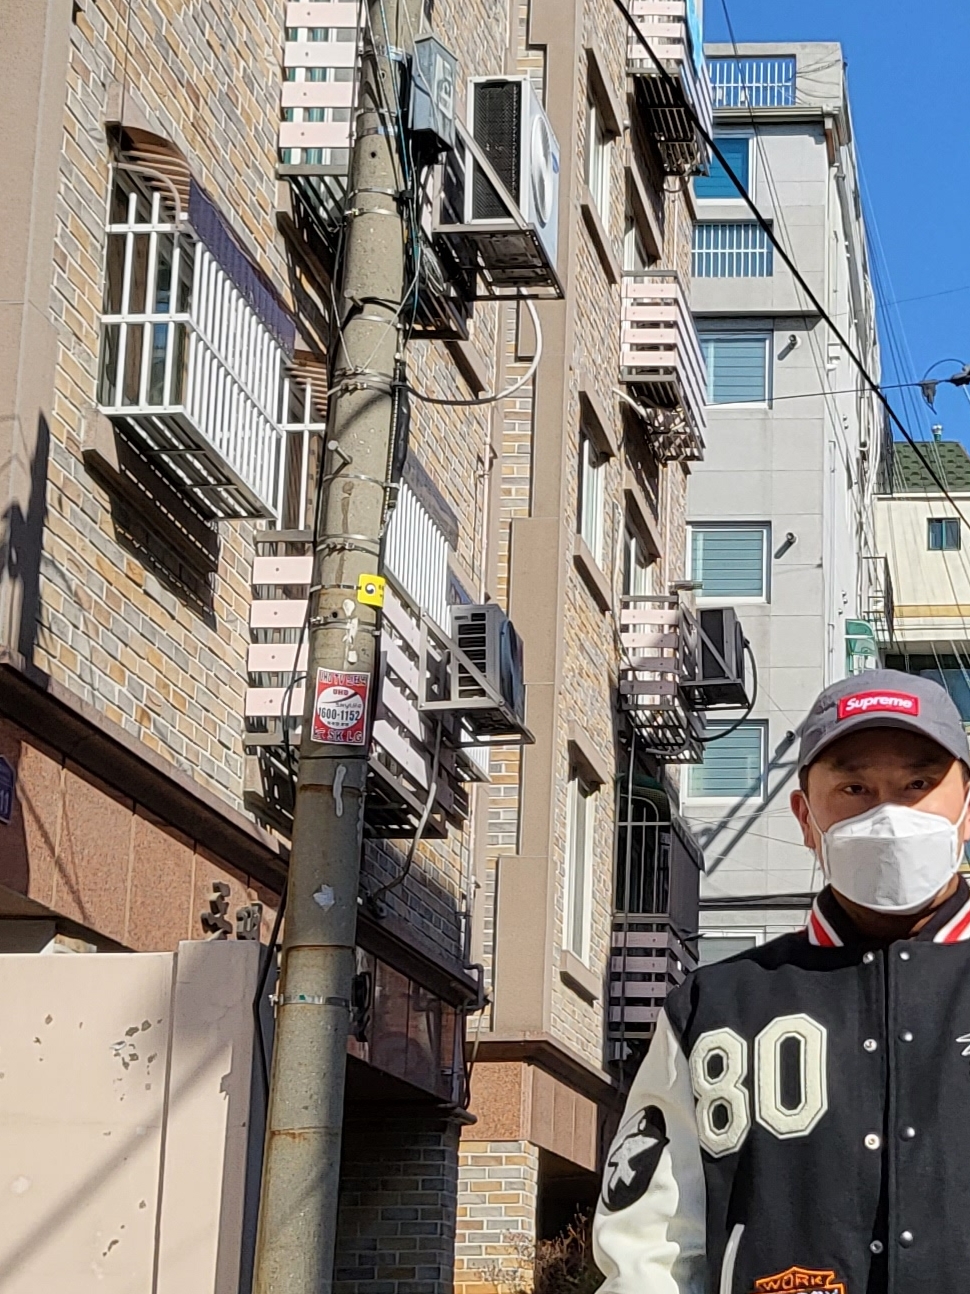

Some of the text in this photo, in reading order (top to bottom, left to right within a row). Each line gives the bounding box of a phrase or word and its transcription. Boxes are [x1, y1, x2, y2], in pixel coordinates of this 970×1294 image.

[845, 696, 913, 711] Supreme
[689, 1013, 828, 1158] 80
[763, 1274, 823, 1290] WORK
